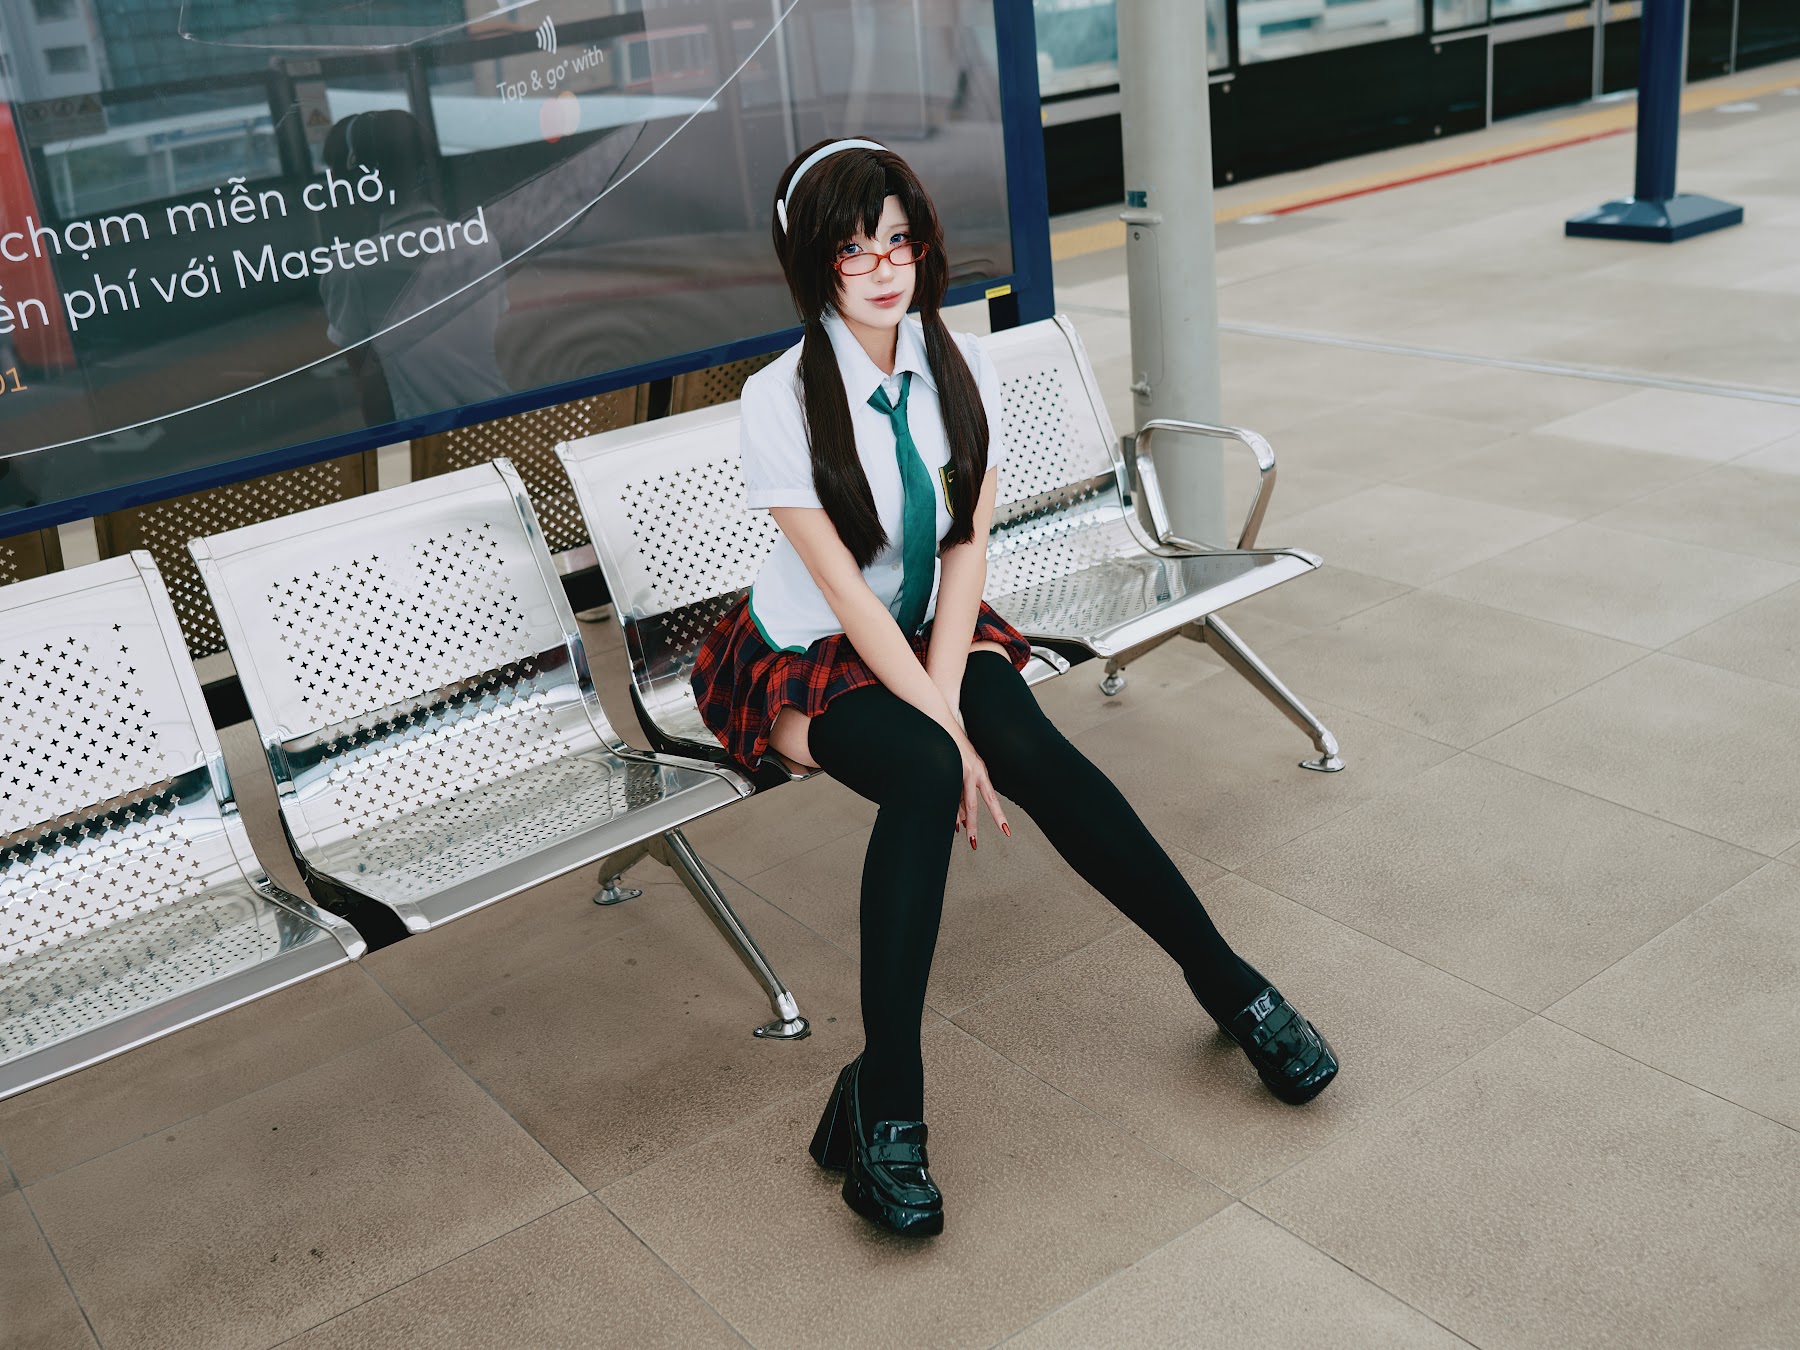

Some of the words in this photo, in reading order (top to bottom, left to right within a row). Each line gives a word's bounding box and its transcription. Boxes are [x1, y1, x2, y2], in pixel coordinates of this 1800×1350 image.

[496, 81, 528, 104] Tap
[531, 70, 543, 91] &
[572, 45, 604, 73] with
[0, 215, 150, 262] chạm
[166, 176, 287, 235] miễn
[302, 164, 396, 211] chờ,
[63, 268, 141, 331] phí
[150, 255, 222, 303] với
[232, 206, 489, 290] Mastercard
